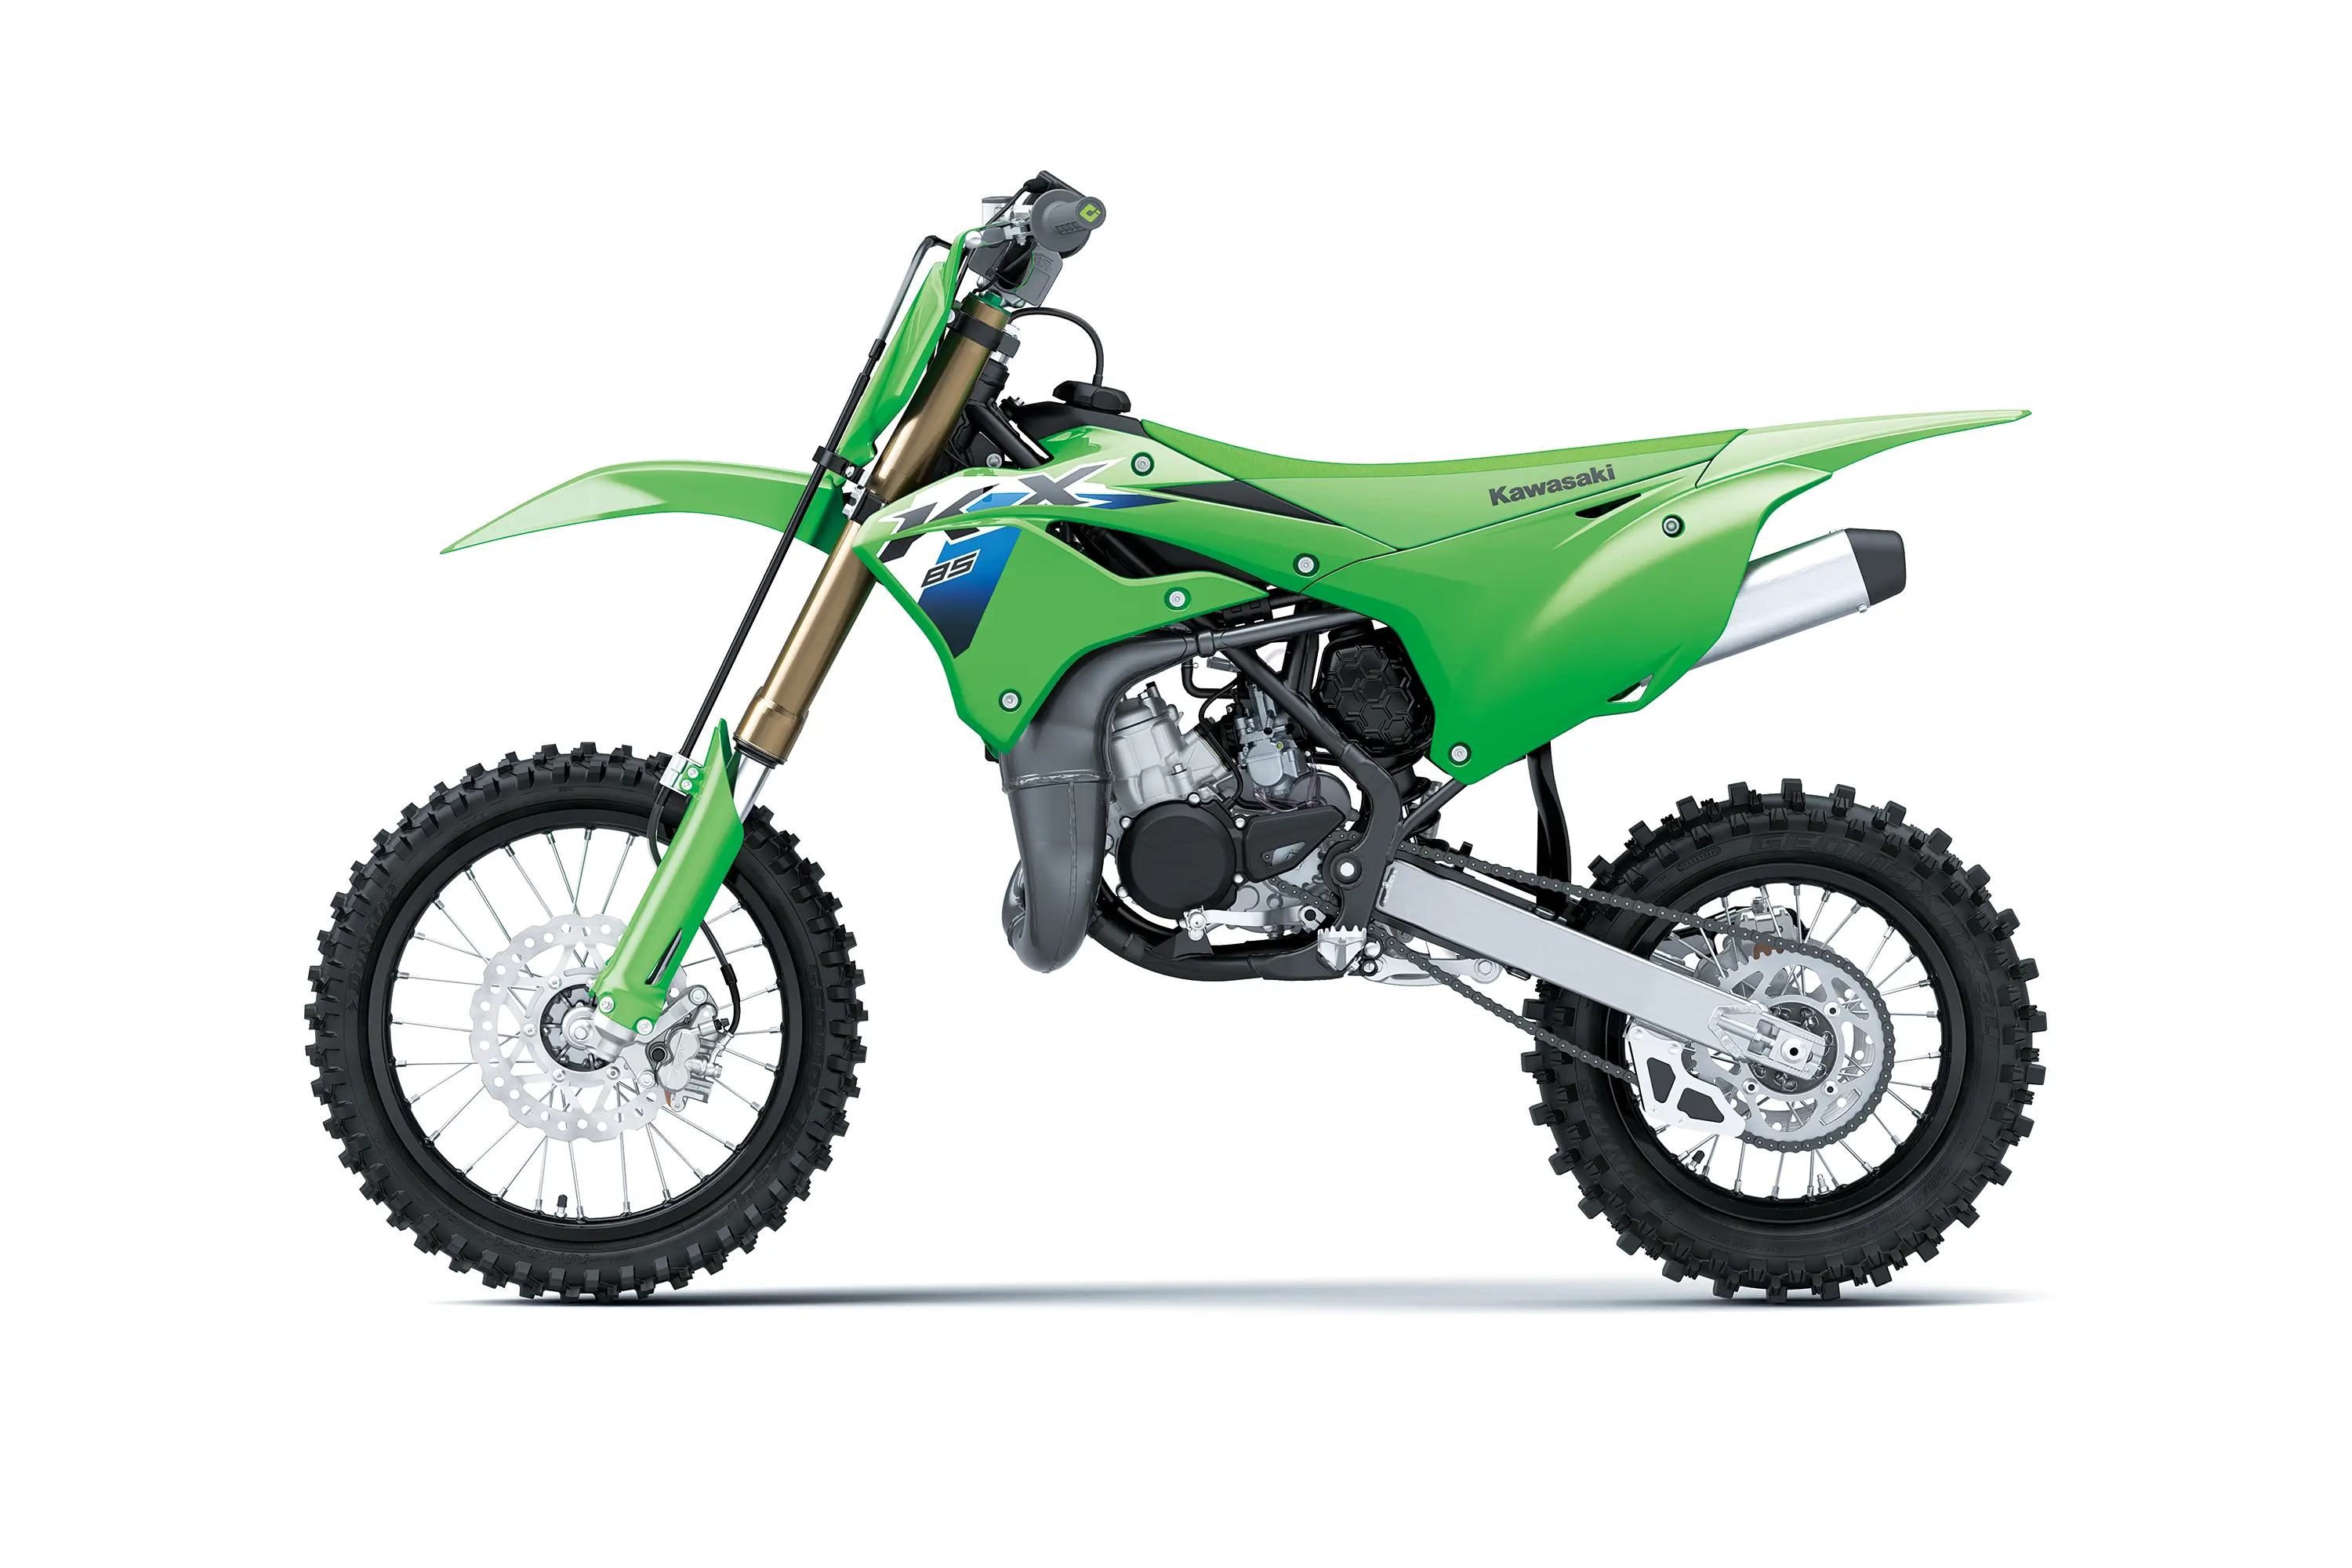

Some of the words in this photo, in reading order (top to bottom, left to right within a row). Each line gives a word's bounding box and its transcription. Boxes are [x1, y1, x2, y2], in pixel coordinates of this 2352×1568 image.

[1489, 464, 1616, 506] Kawasaki
[922, 552, 978, 587] 85
[1749, 832, 1939, 908] GEOMAX
[347, 884, 398, 995] DUNLOP
[1579, 1080, 1661, 1205] DUNLOP
